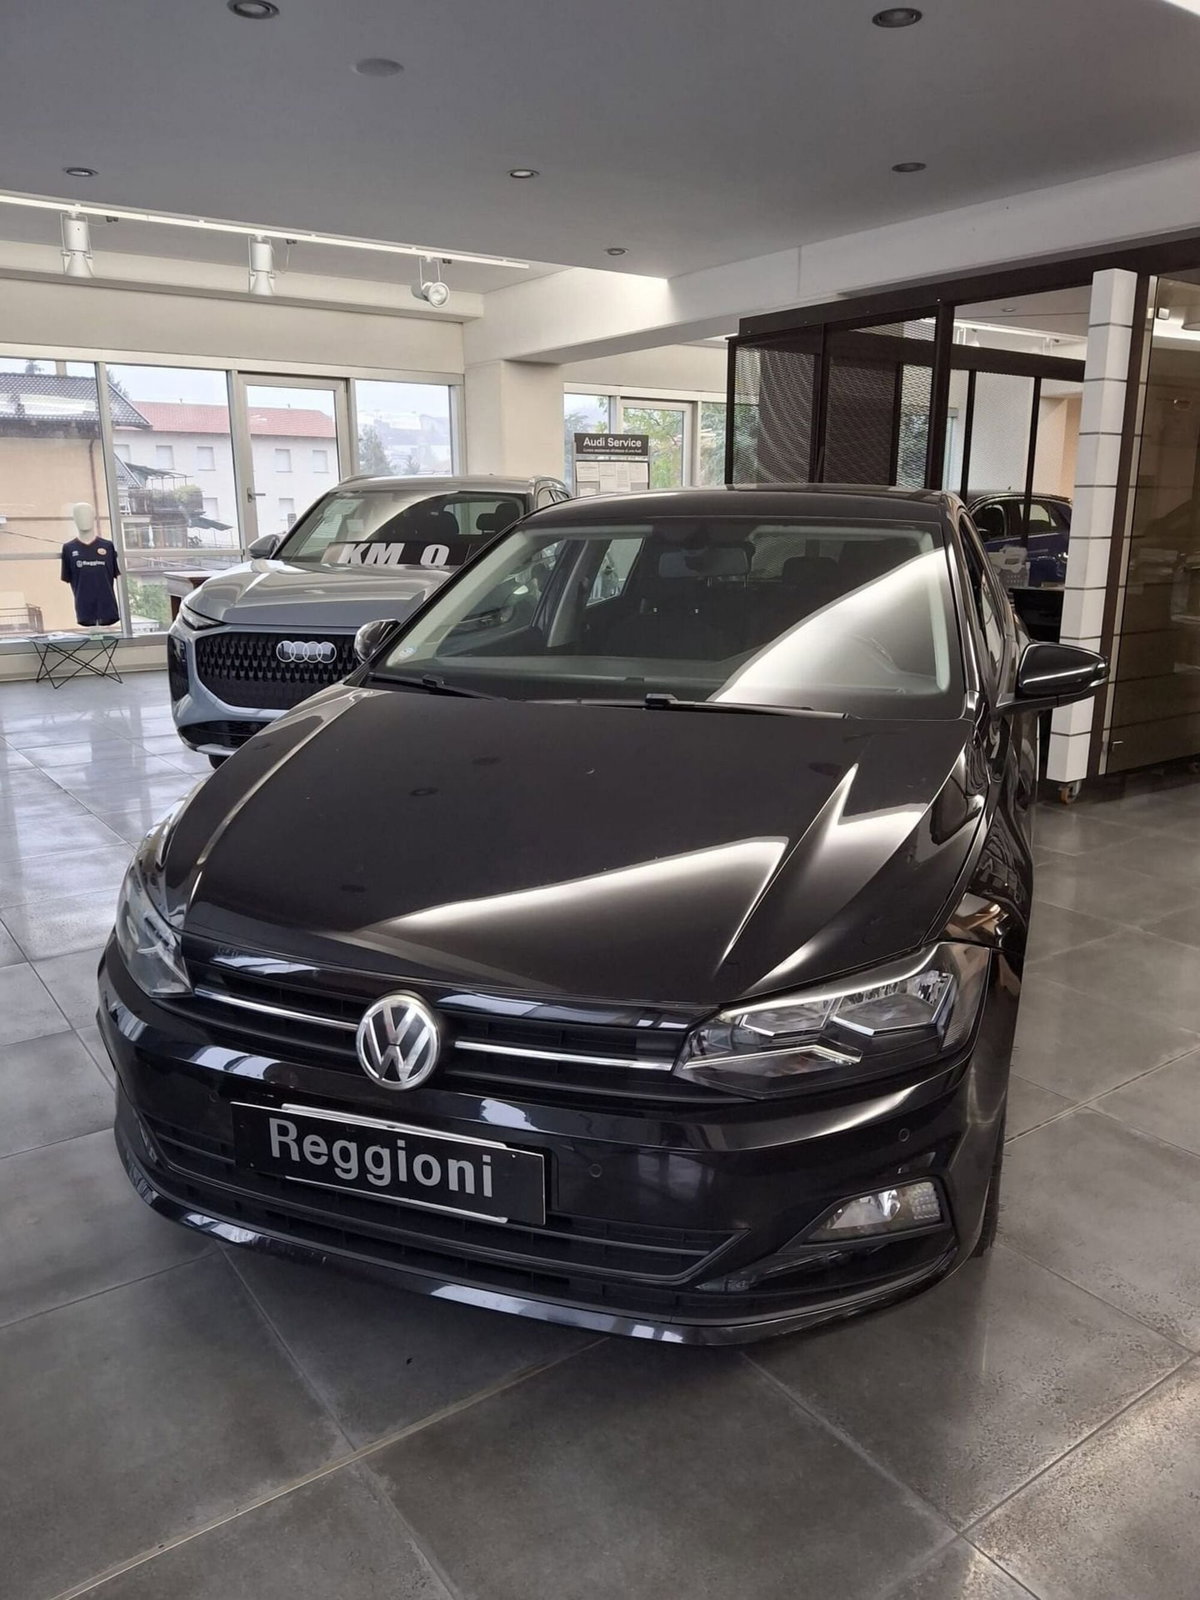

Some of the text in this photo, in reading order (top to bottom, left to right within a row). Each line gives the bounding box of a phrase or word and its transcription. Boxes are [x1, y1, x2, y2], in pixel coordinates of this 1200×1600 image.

[583, 437, 642, 447] Audi Service
[337, 542, 405, 565] KM
[268, 1117, 493, 1198] Reggioni
